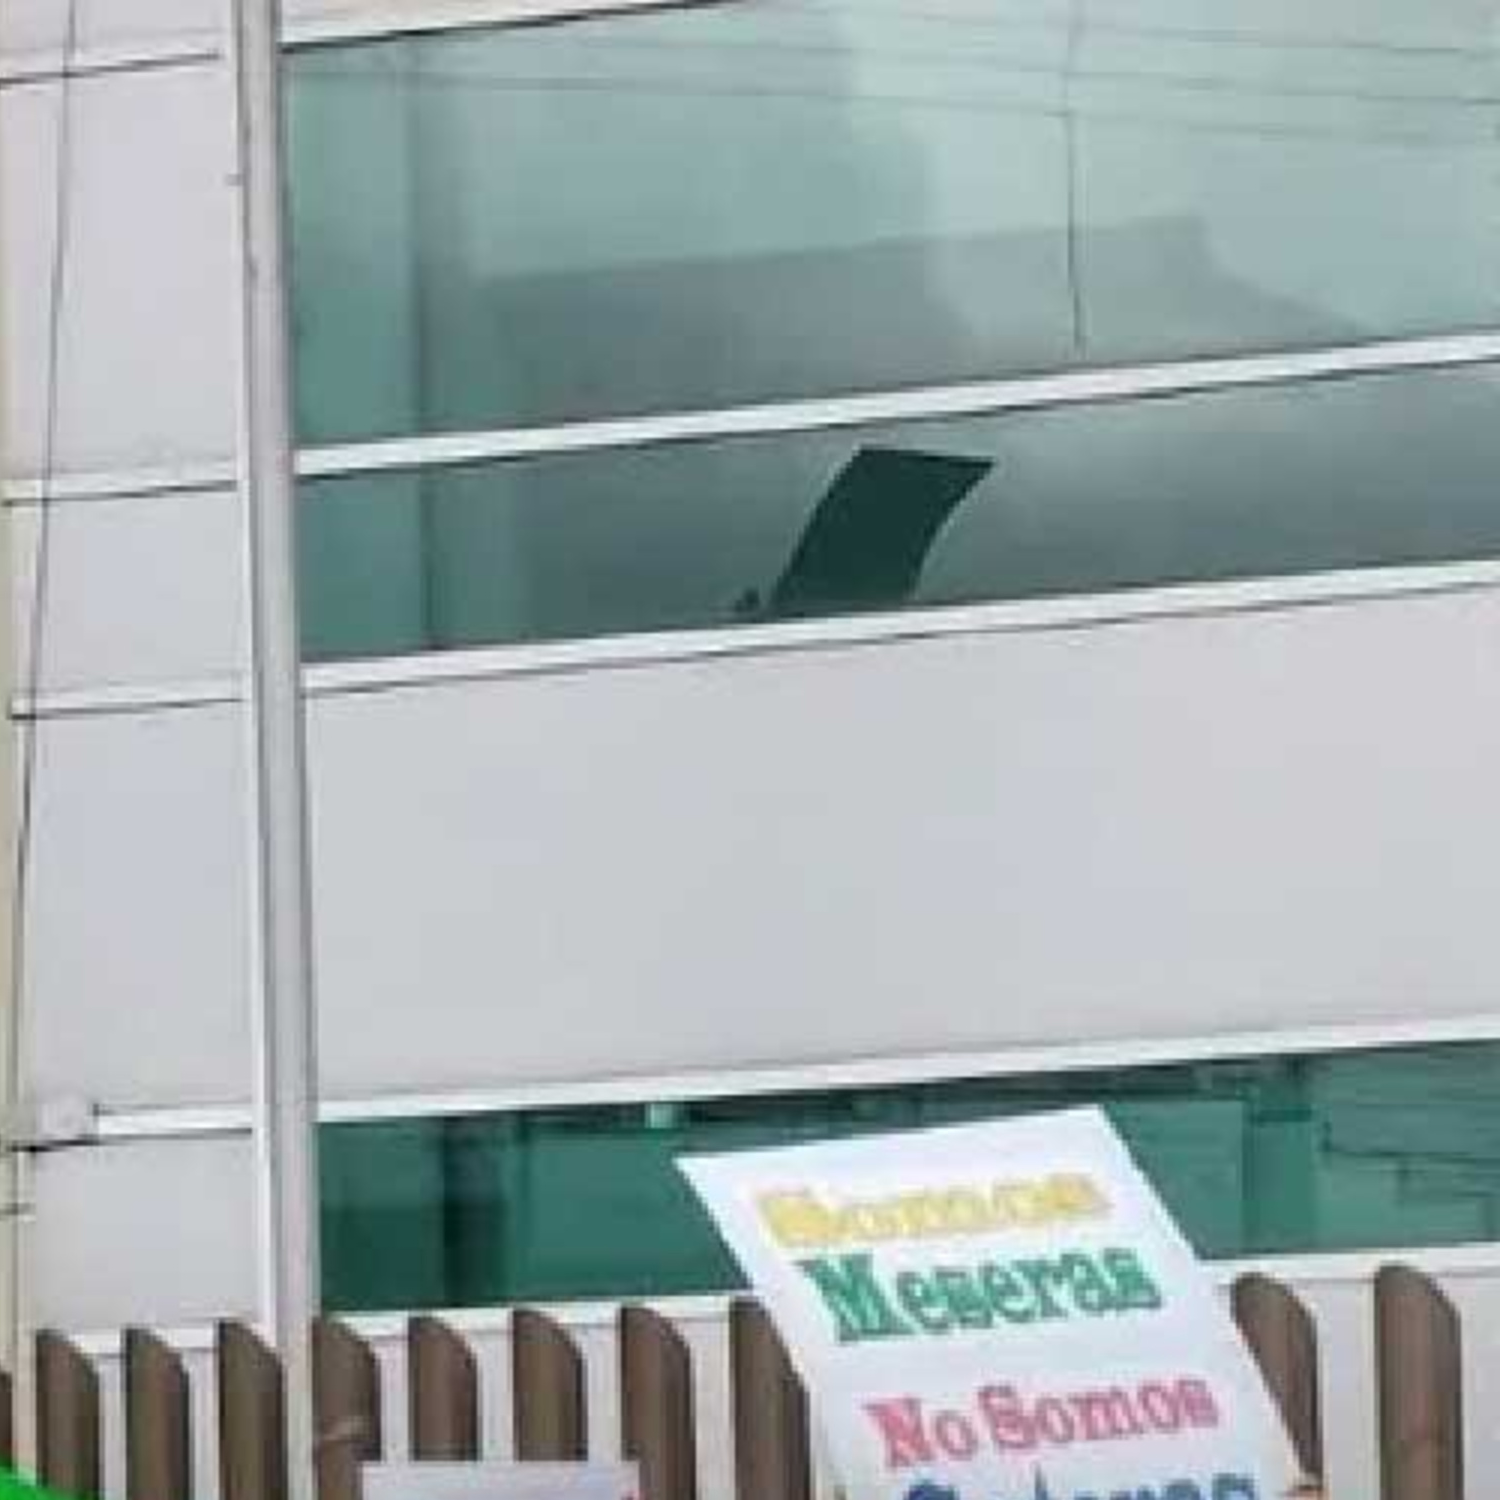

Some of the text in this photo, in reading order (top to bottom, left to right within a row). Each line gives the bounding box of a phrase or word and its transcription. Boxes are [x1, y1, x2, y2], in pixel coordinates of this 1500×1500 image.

[797, 1247, 1163, 1344] Meseras
[866, 1377, 1220, 1469] No Somos
